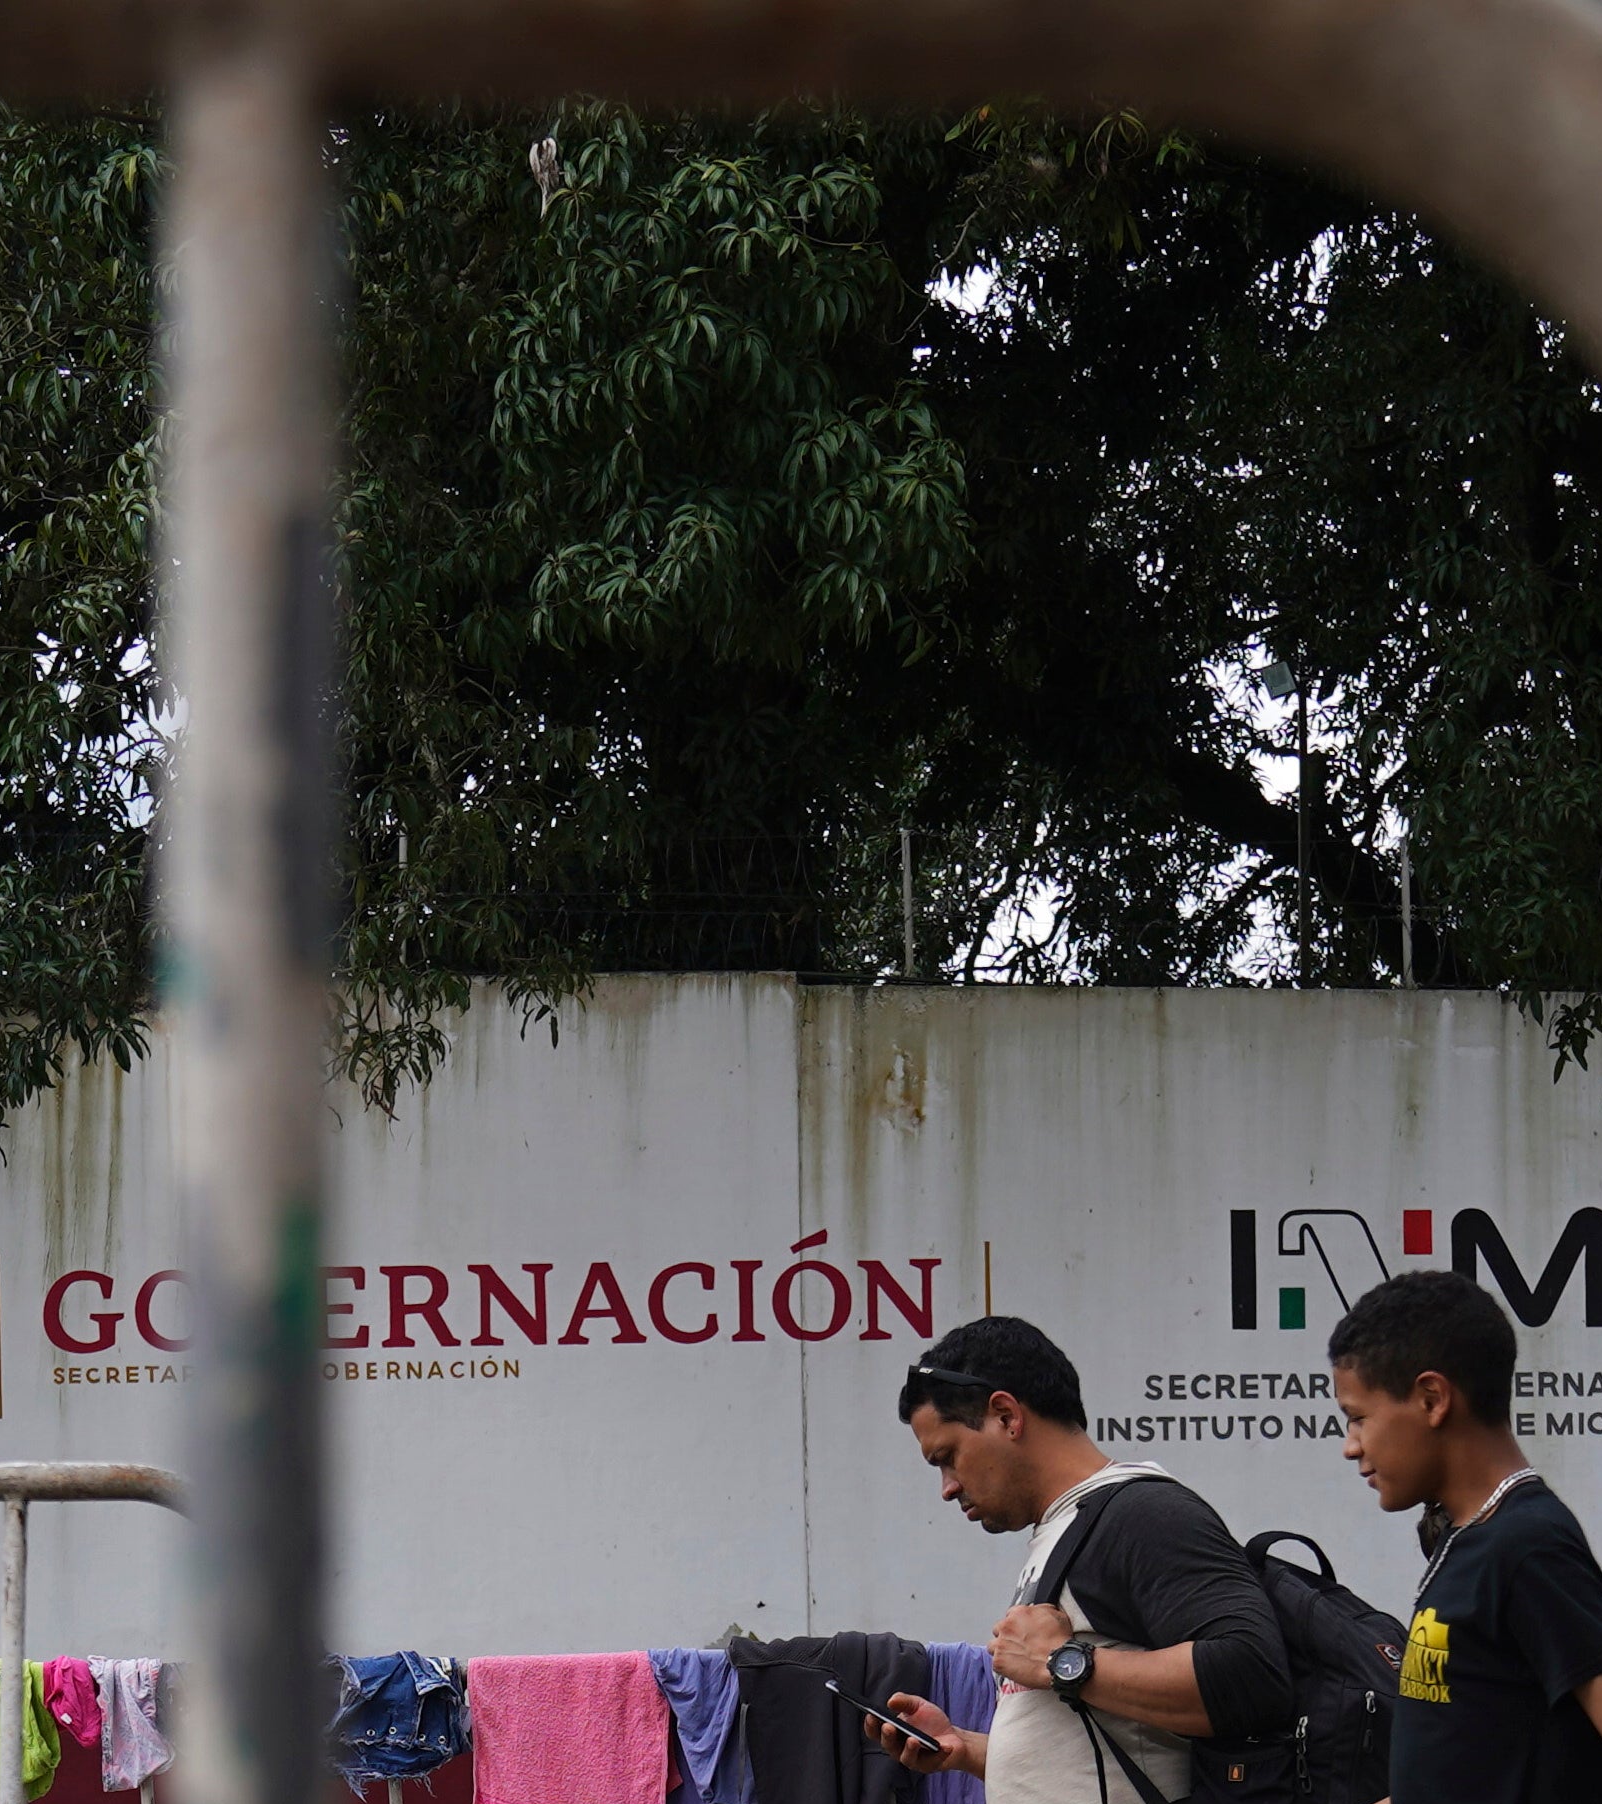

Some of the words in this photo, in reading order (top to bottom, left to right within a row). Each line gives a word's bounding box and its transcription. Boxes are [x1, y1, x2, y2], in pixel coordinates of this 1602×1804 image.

[42, 1228, 943, 1355] GOERNACIÓN
[322, 1354, 521, 1382] OBERNACIÓN
[1143, 1373, 1337, 1401] SECRETAR
[1096, 1415, 1284, 1443] INSTITUTO
[1515, 1412, 1536, 1436] E
